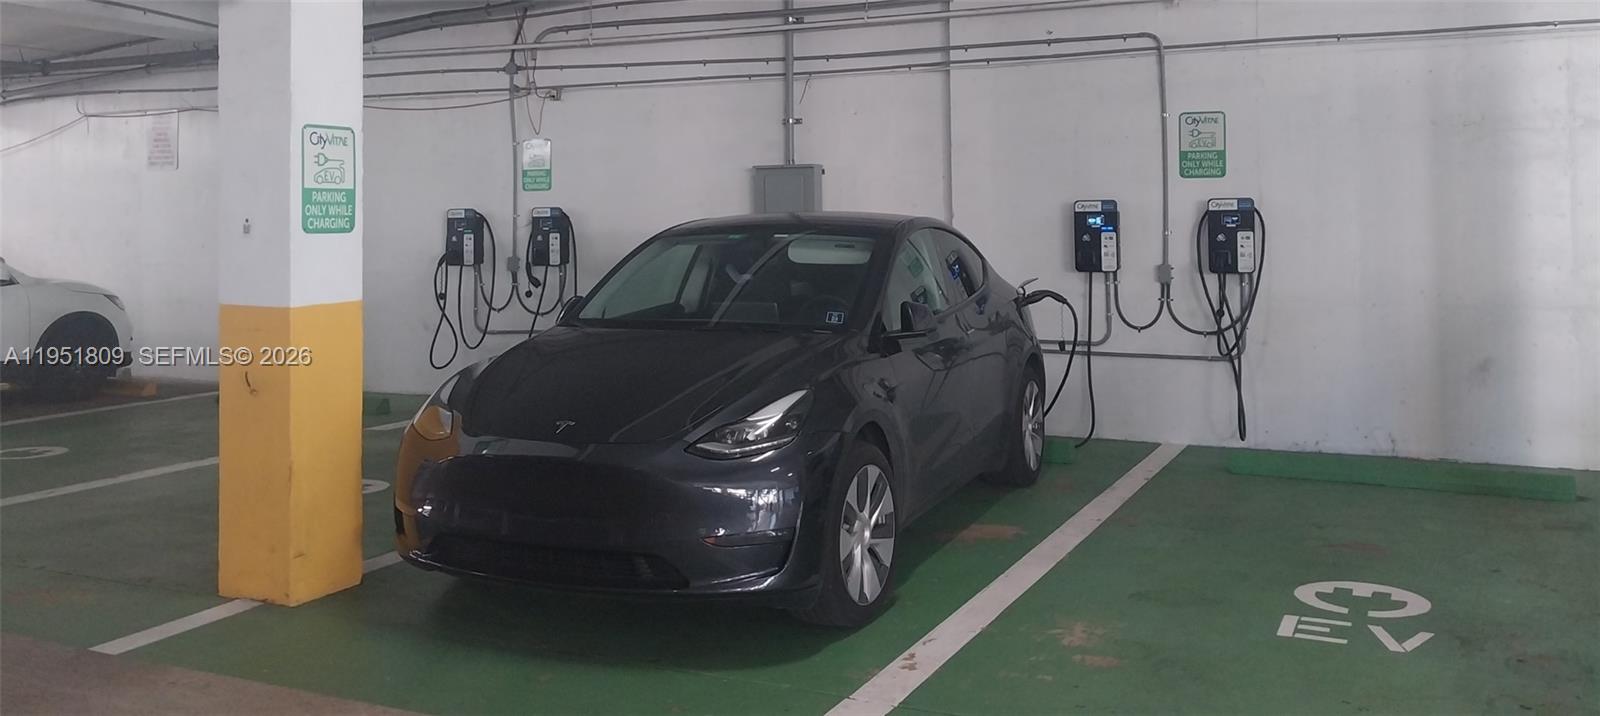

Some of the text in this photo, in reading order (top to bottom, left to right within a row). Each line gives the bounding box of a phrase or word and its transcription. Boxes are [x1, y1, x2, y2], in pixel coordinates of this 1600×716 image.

[1181, 159, 1224, 168] ONLY WHILE
[1183, 167, 1221, 176] CHARGING
[312, 191, 347, 203] PARKING
[305, 204, 353, 216] ONLY WHILE
[307, 217, 350, 229] CHARGING
[1276, 614, 1435, 653] EV
